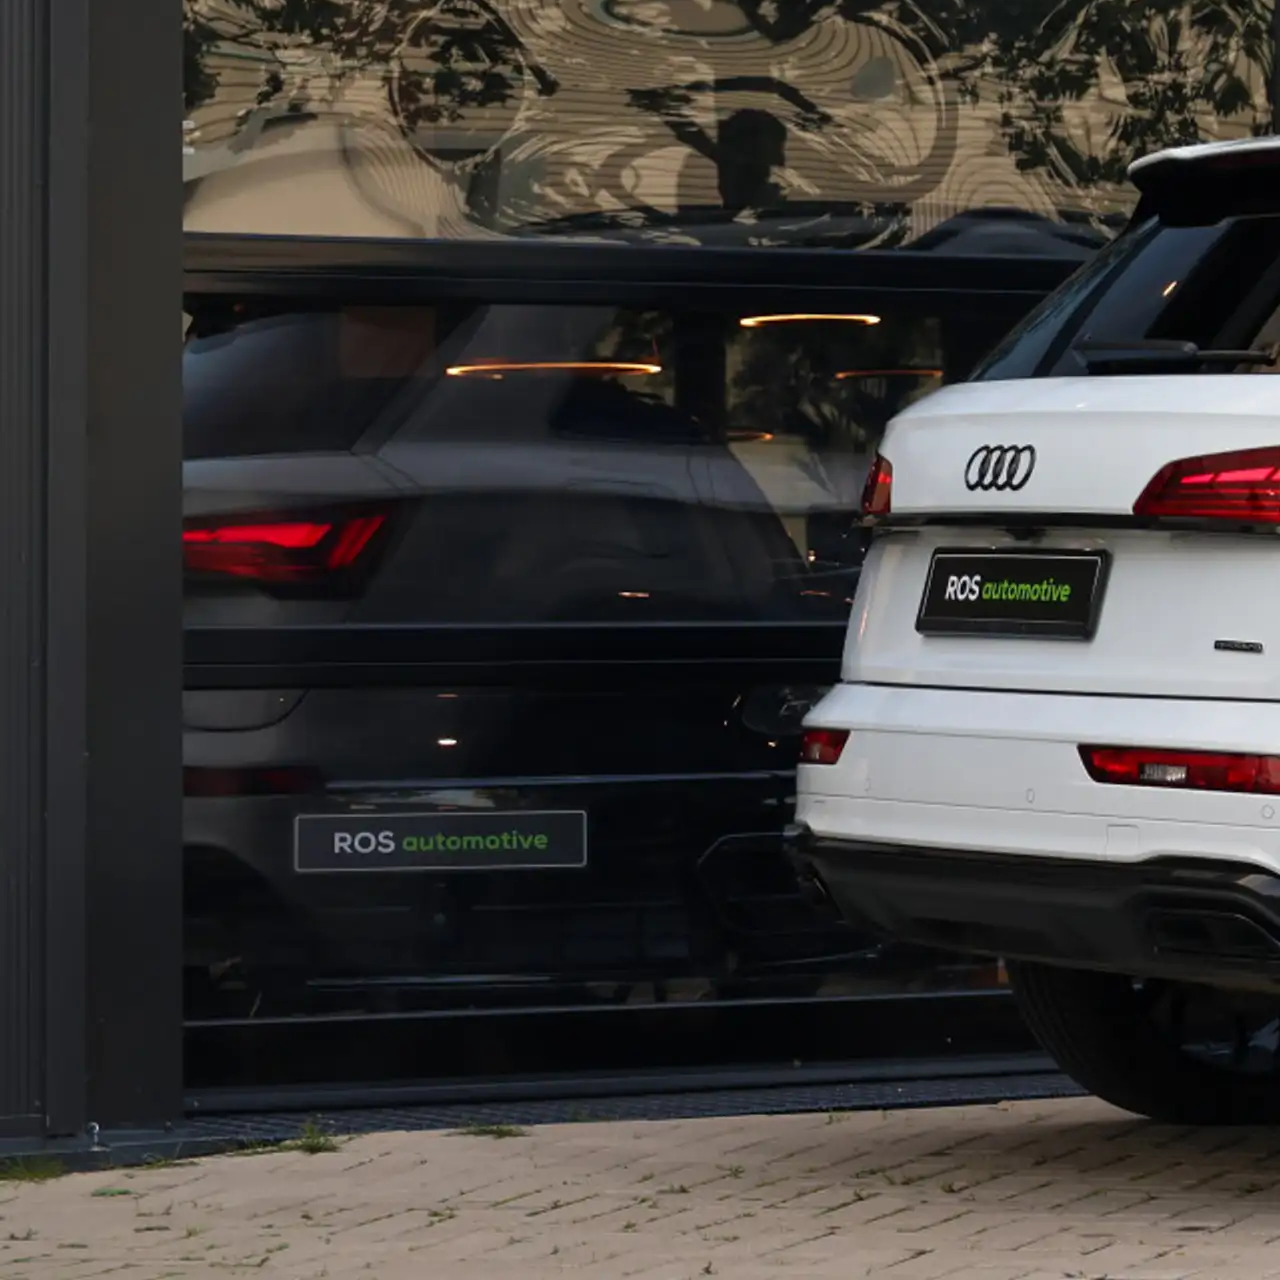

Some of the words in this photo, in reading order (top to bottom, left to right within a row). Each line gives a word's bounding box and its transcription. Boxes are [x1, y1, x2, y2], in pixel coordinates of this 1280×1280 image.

[944, 575, 981, 601] ROS
[982, 578, 1071, 601] automotive
[333, 831, 395, 854] ROS
[402, 830, 549, 852] automotive
